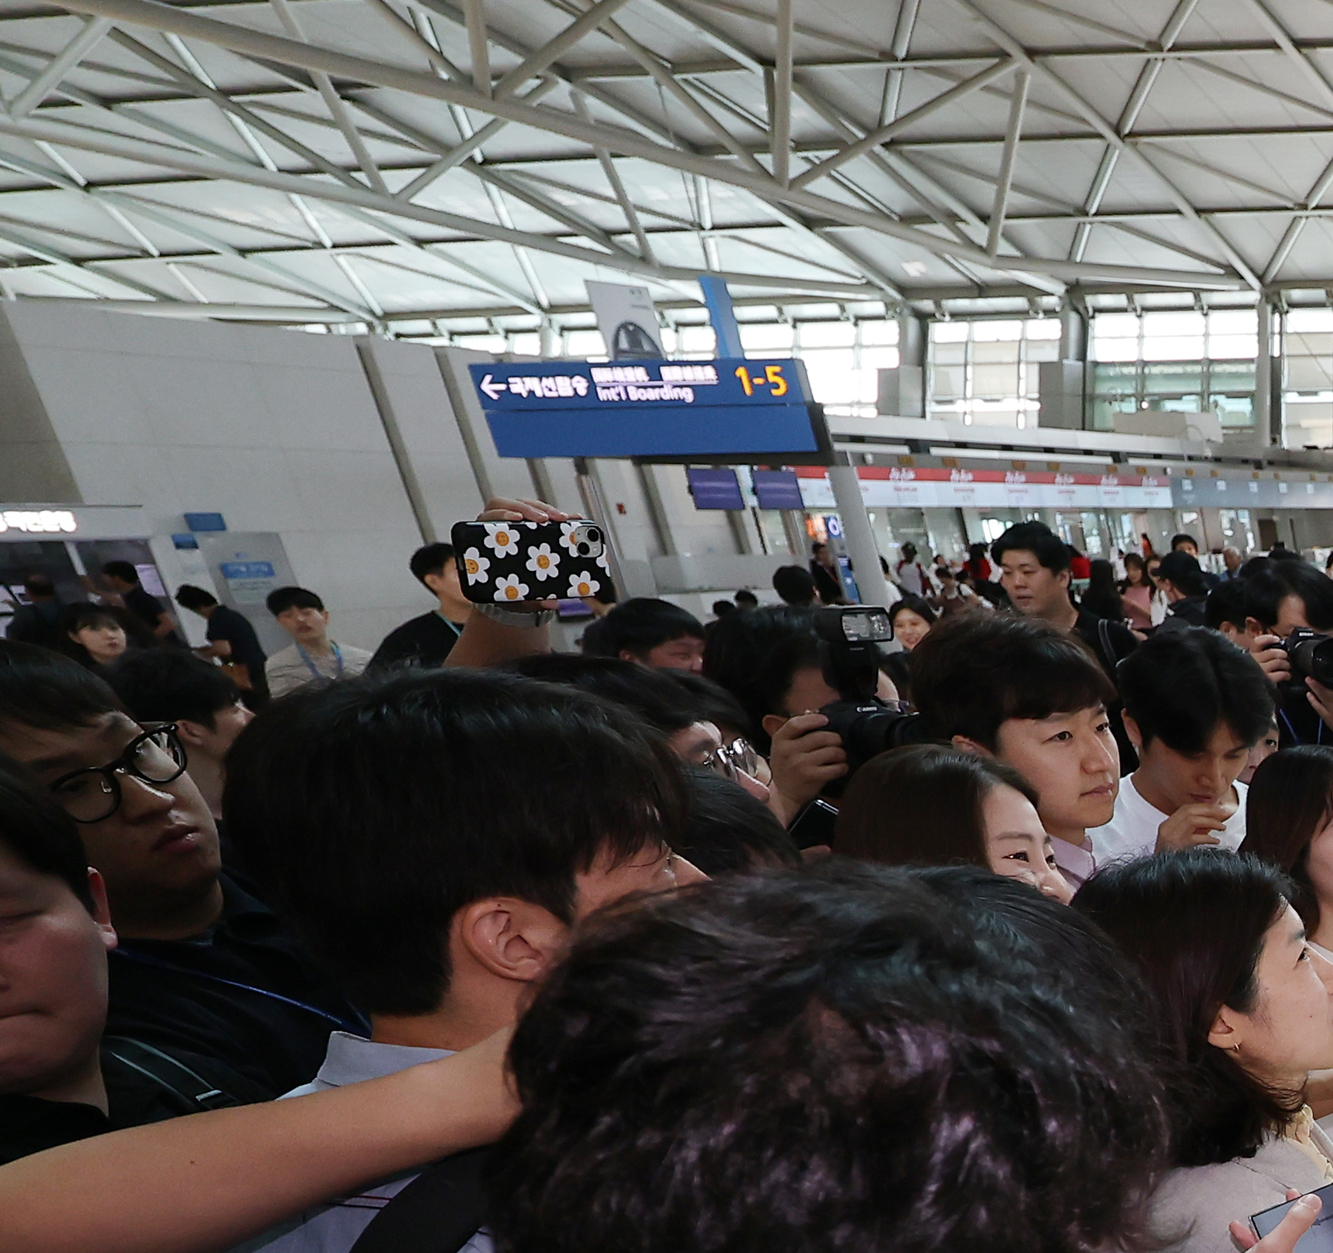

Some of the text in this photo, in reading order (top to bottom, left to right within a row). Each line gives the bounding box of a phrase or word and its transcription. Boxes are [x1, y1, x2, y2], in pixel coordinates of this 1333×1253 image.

[596, 384, 695, 404] Int'l Boarding
[735, 365, 788, 397] 1-5
